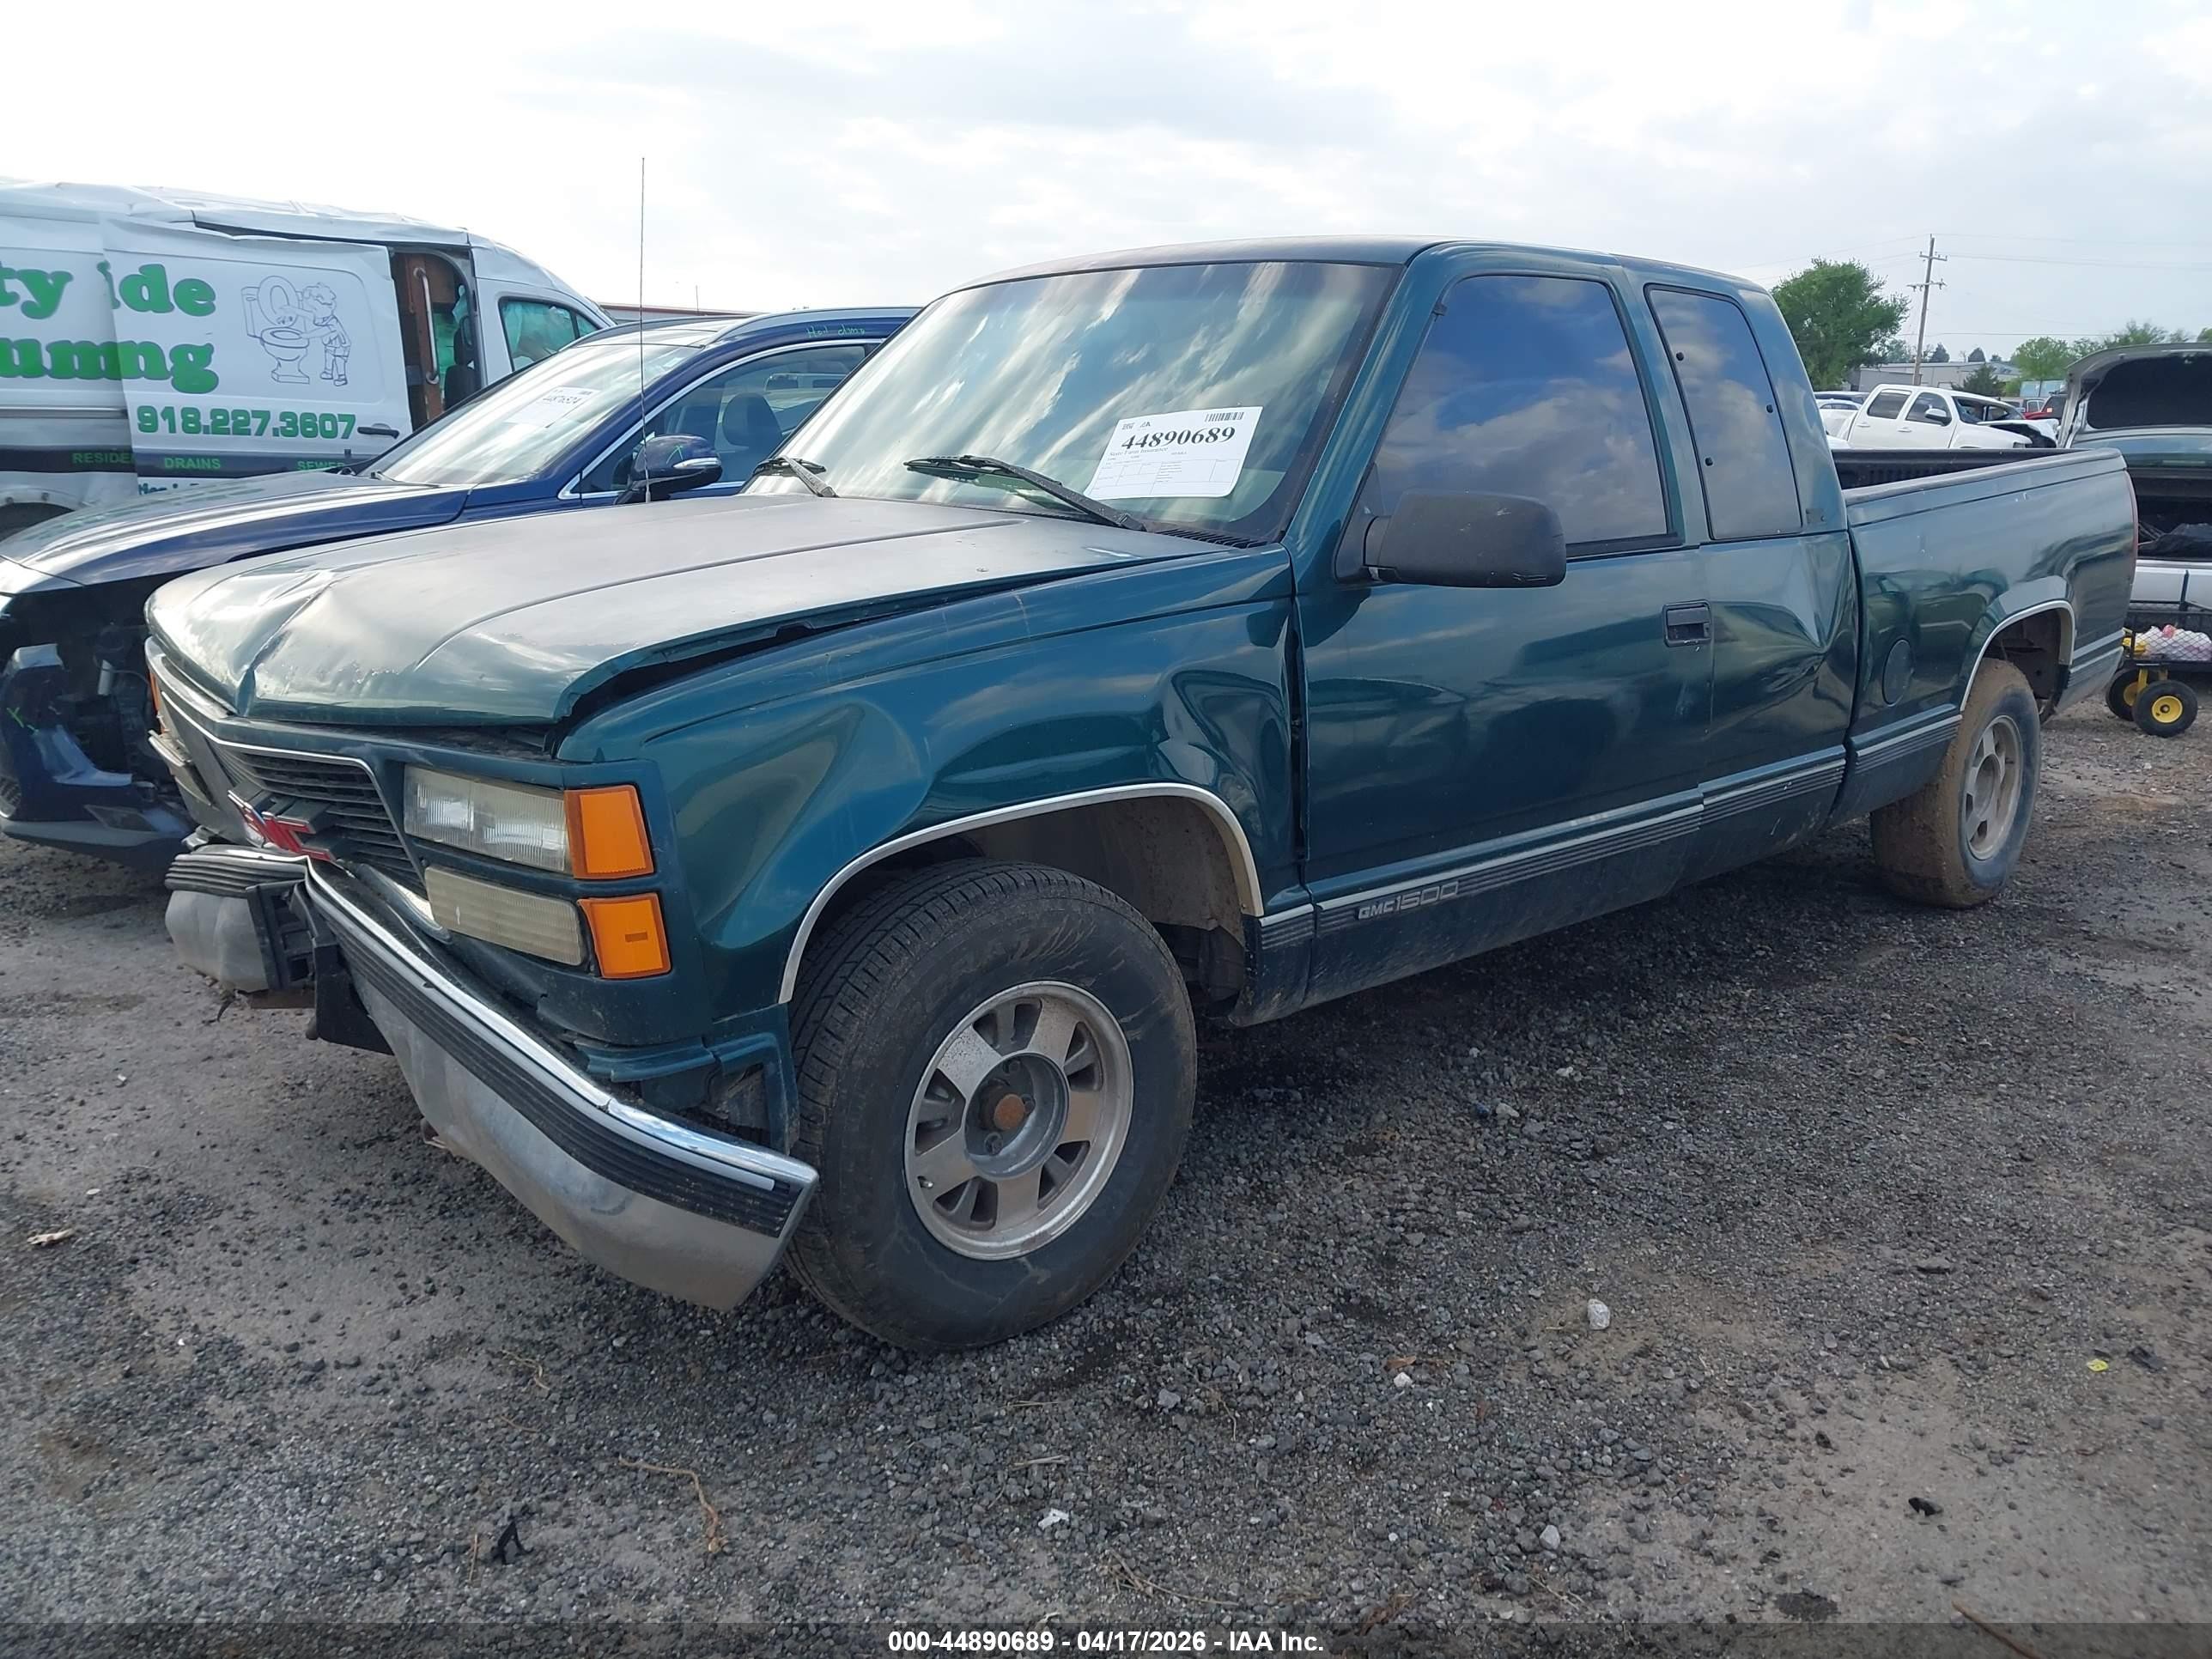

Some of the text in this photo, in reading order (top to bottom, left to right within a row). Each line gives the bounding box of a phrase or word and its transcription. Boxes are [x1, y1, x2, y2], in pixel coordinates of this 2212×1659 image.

[137, 404, 356, 440] 918.227.3607
[1121, 427, 1236, 450] 44890689
[164, 457, 222, 471] DRAINS
